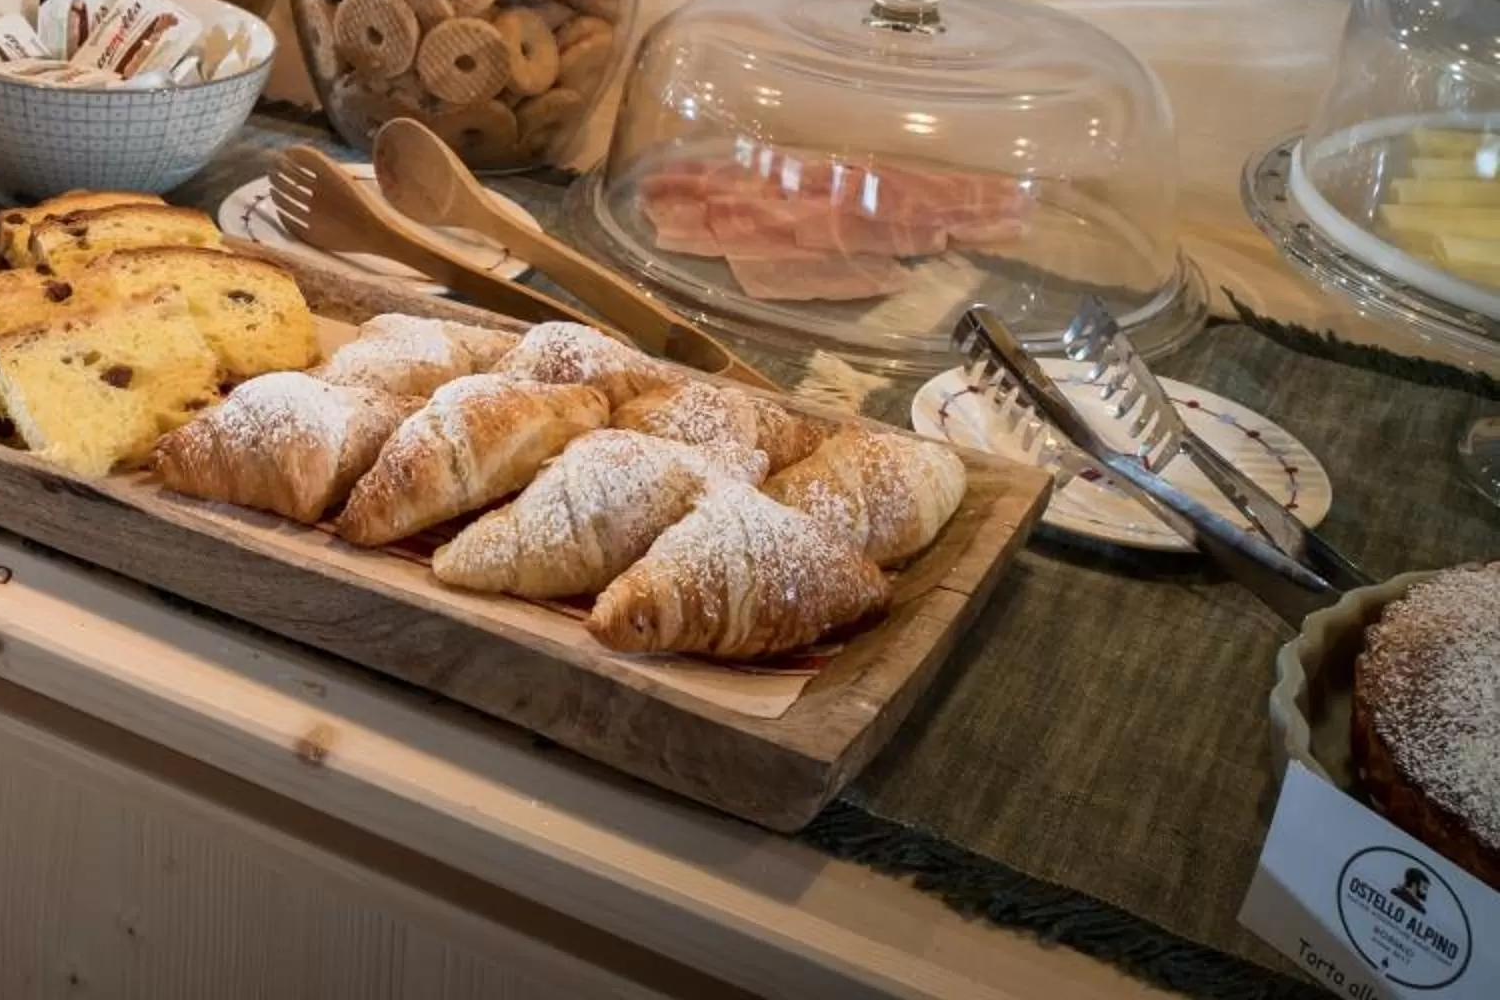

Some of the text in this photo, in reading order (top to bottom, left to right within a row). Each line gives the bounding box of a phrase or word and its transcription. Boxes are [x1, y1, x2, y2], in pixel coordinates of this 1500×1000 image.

[1348, 876, 1406, 924] OSTELLO
[1404, 916, 1460, 961] ALPINO
[1349, 982, 1379, 1000] all
